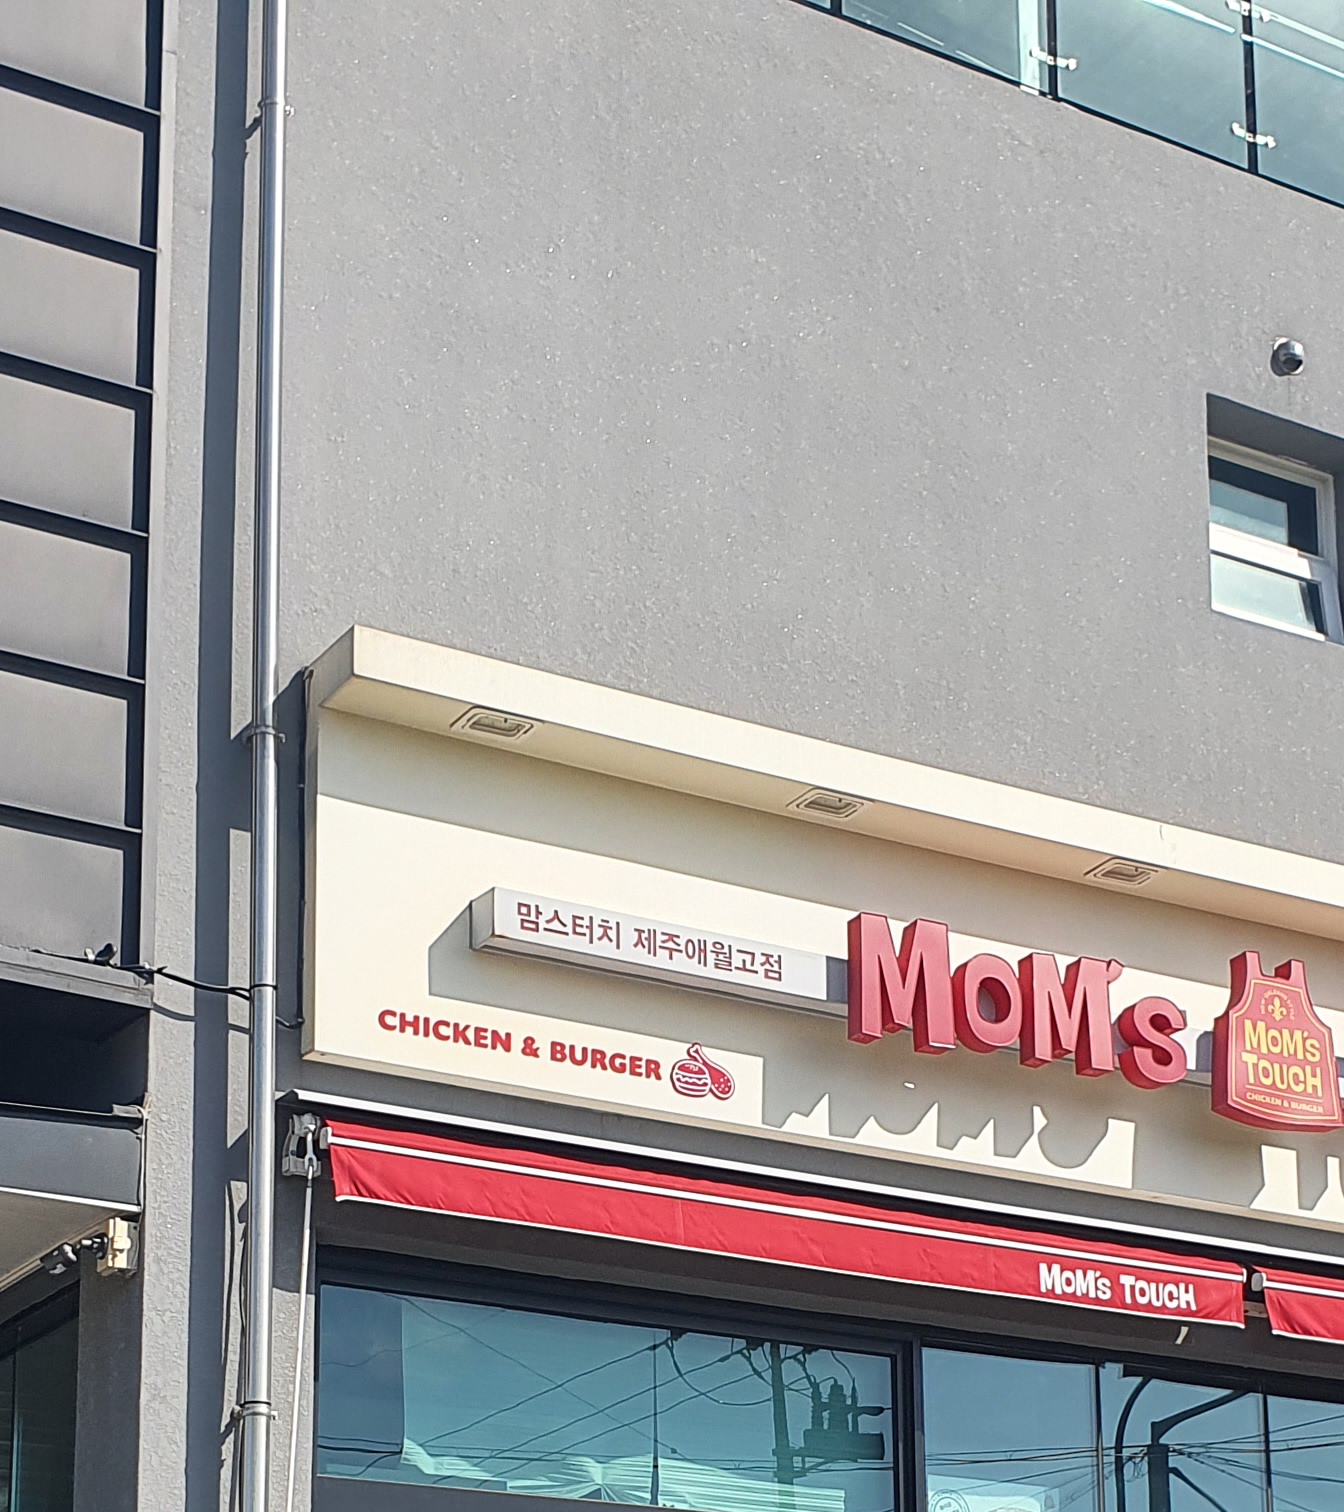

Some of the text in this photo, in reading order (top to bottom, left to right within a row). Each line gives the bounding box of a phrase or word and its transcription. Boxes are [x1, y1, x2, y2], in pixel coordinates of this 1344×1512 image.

[517, 902, 783, 981] 맘스터치 제주애월고점
[378, 1009, 662, 1082] CHICKEN & BURGER
[1241, 1052, 1323, 1097] TOUCH
[1246, 1092, 1282, 1107] CHICKEN
[1291, 1101, 1324, 1114] BURGER
[1119, 1274, 1196, 1311] TOUCH
